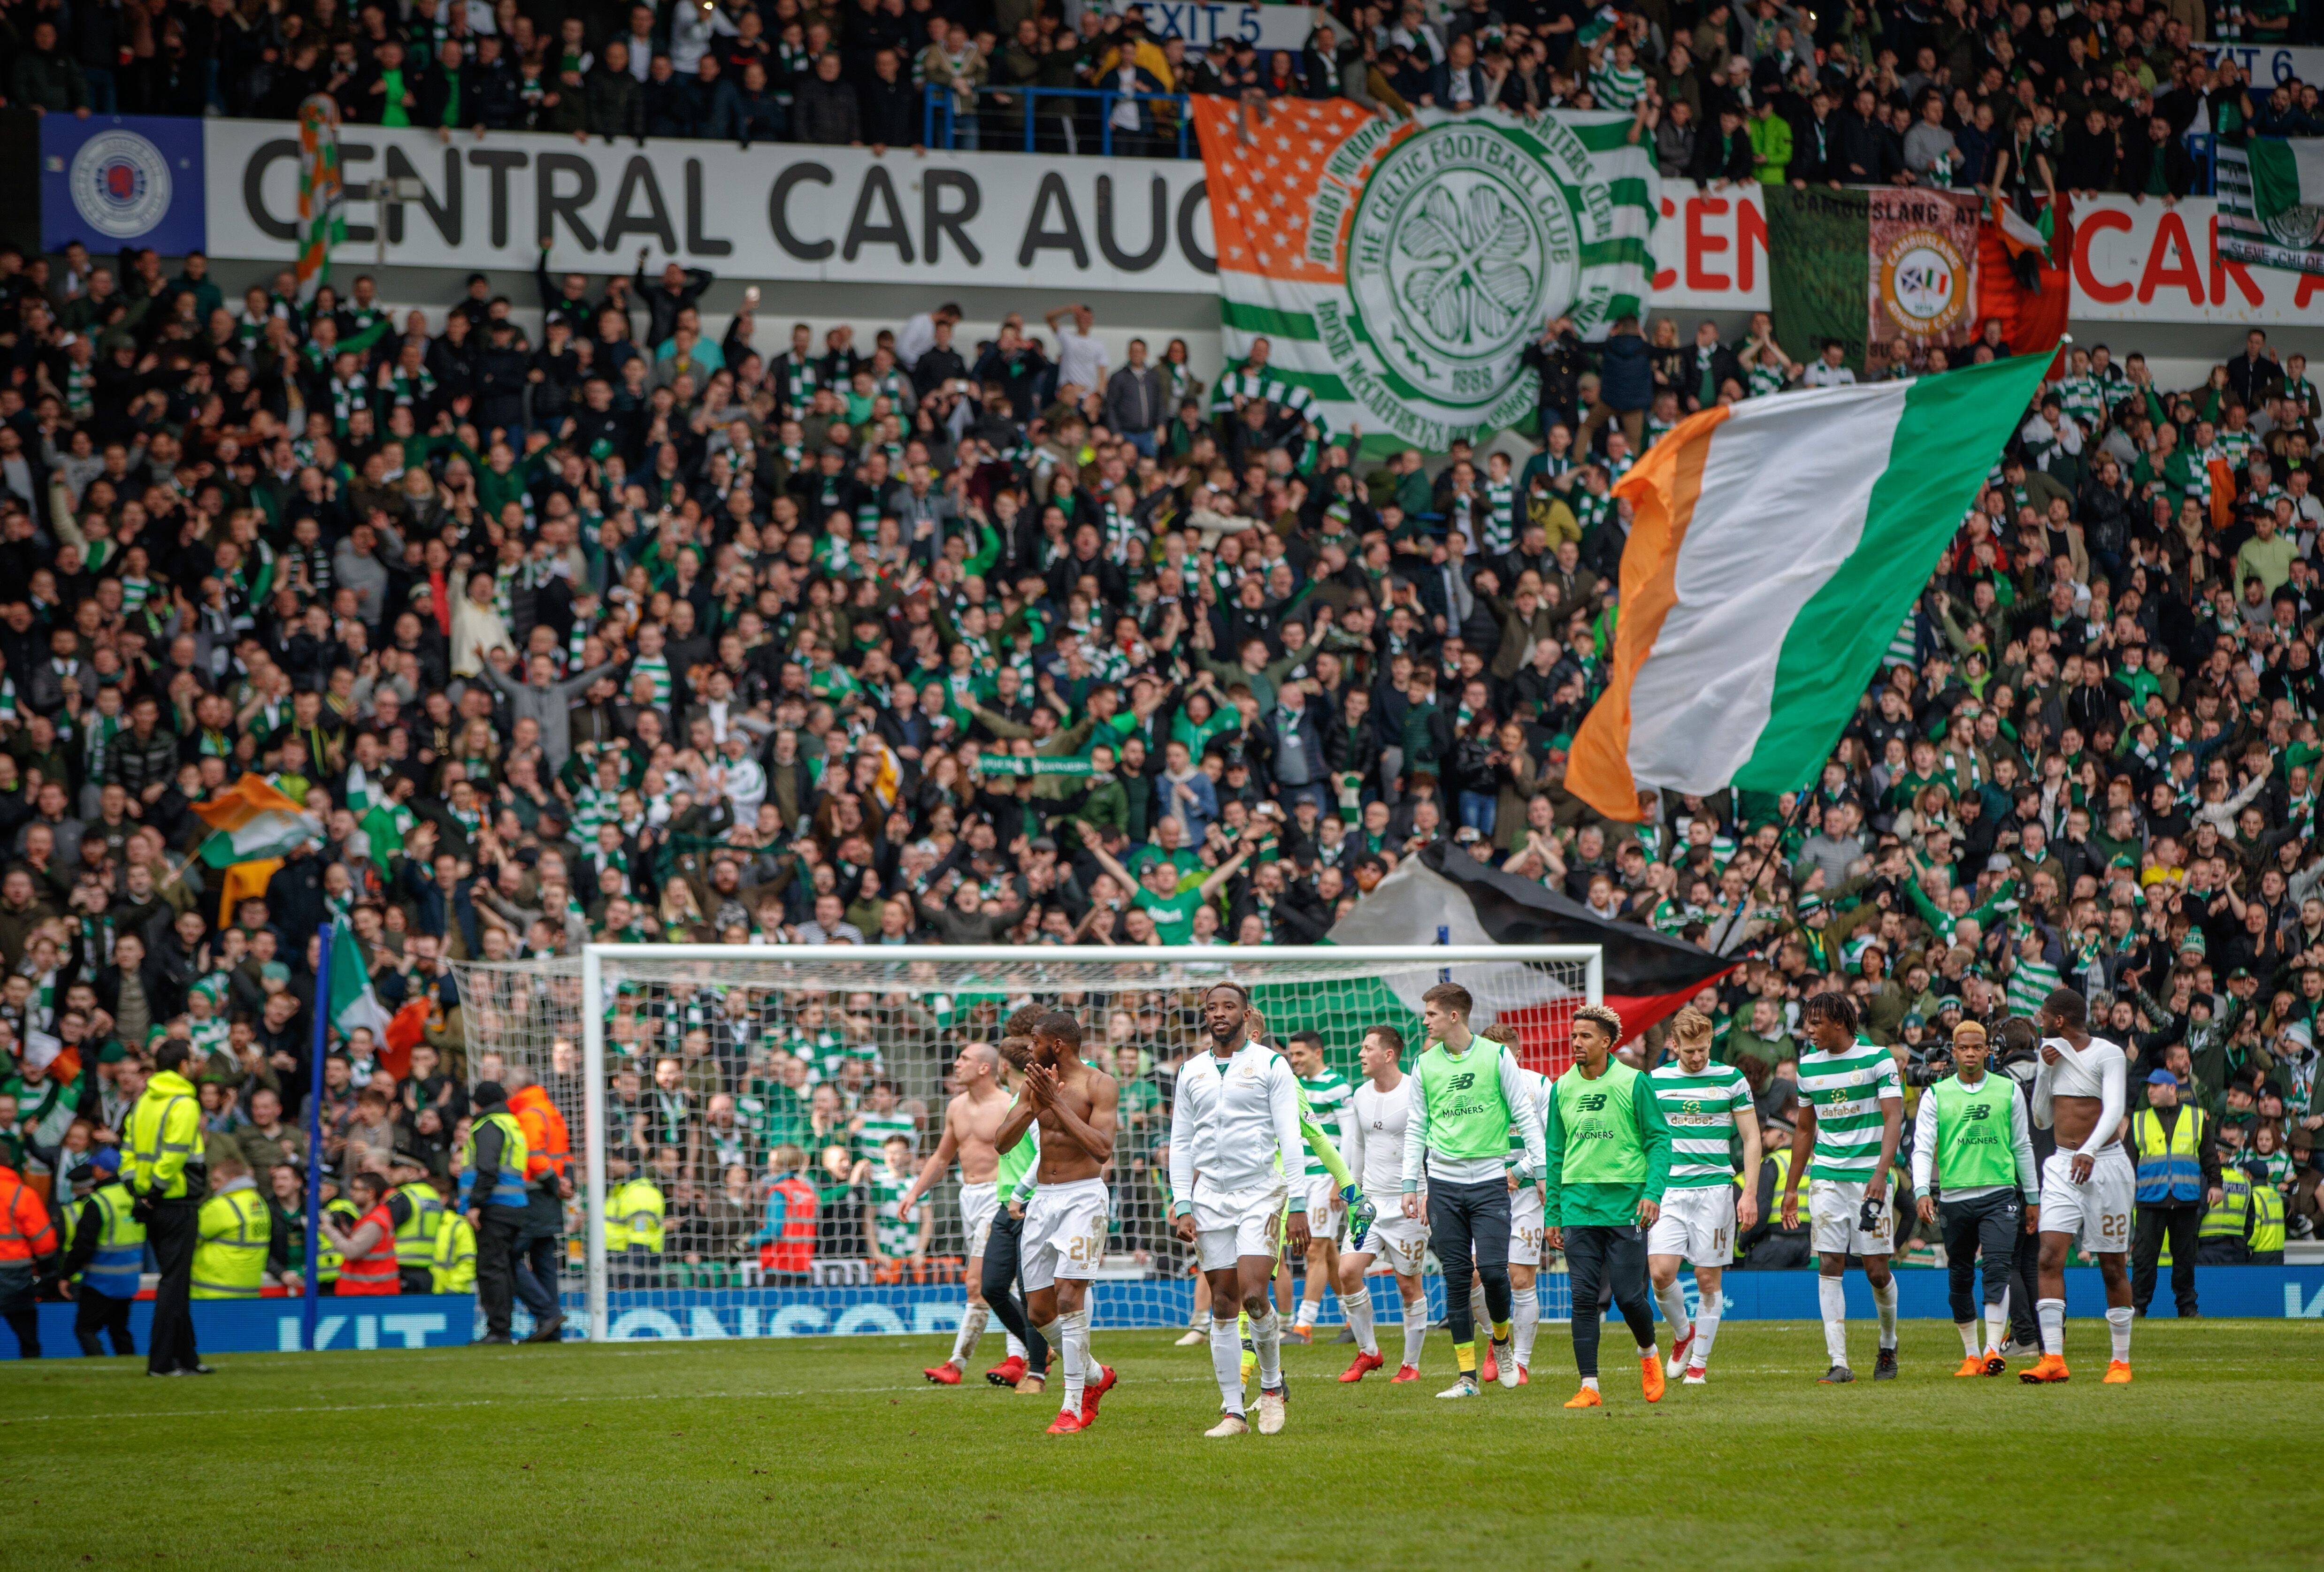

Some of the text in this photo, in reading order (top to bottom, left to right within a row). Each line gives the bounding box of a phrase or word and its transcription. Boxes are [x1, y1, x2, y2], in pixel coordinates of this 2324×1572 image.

[1240, 8, 1262, 44] 5
[2272, 49, 2293, 87] 6
[1328, 113, 1404, 179] MURDO
[243, 139, 733, 256] CENTRAL
[768, 160, 983, 267] CAR
[1359, 135, 1571, 278] THE CELTIC FOOTBALL CLUB
[1794, 191, 1940, 223] CAMBUSLANG
[1310, 179, 1347, 261] BOBBY
[1887, 233, 1961, 270] CAMBUSLANG
[1453, 366, 1494, 393] 1888
[1442, 1105, 1484, 1119] MAGNERS
[1671, 1115, 1713, 1125] dafabet
[1822, 1104, 1860, 1117] dafabet
[1373, 1121, 1383, 1130] 42
[1574, 1130, 1614, 1140] MAGNERS
[1957, 1136, 1998, 1146] MAGNERS
[2225, 1183, 2249, 1194] POLICE
[1264, 1213, 1281, 1239] 10
[1312, 1207, 1328, 1225] 18
[1872, 1216, 1891, 1238] 20
[2102, 1213, 2127, 1236] 22
[1070, 1236, 1091, 1261] 21
[1520, 1227, 1542, 1249] 49
[1713, 1228, 1726, 1250] 14
[1400, 1239, 1425, 1260] 42
